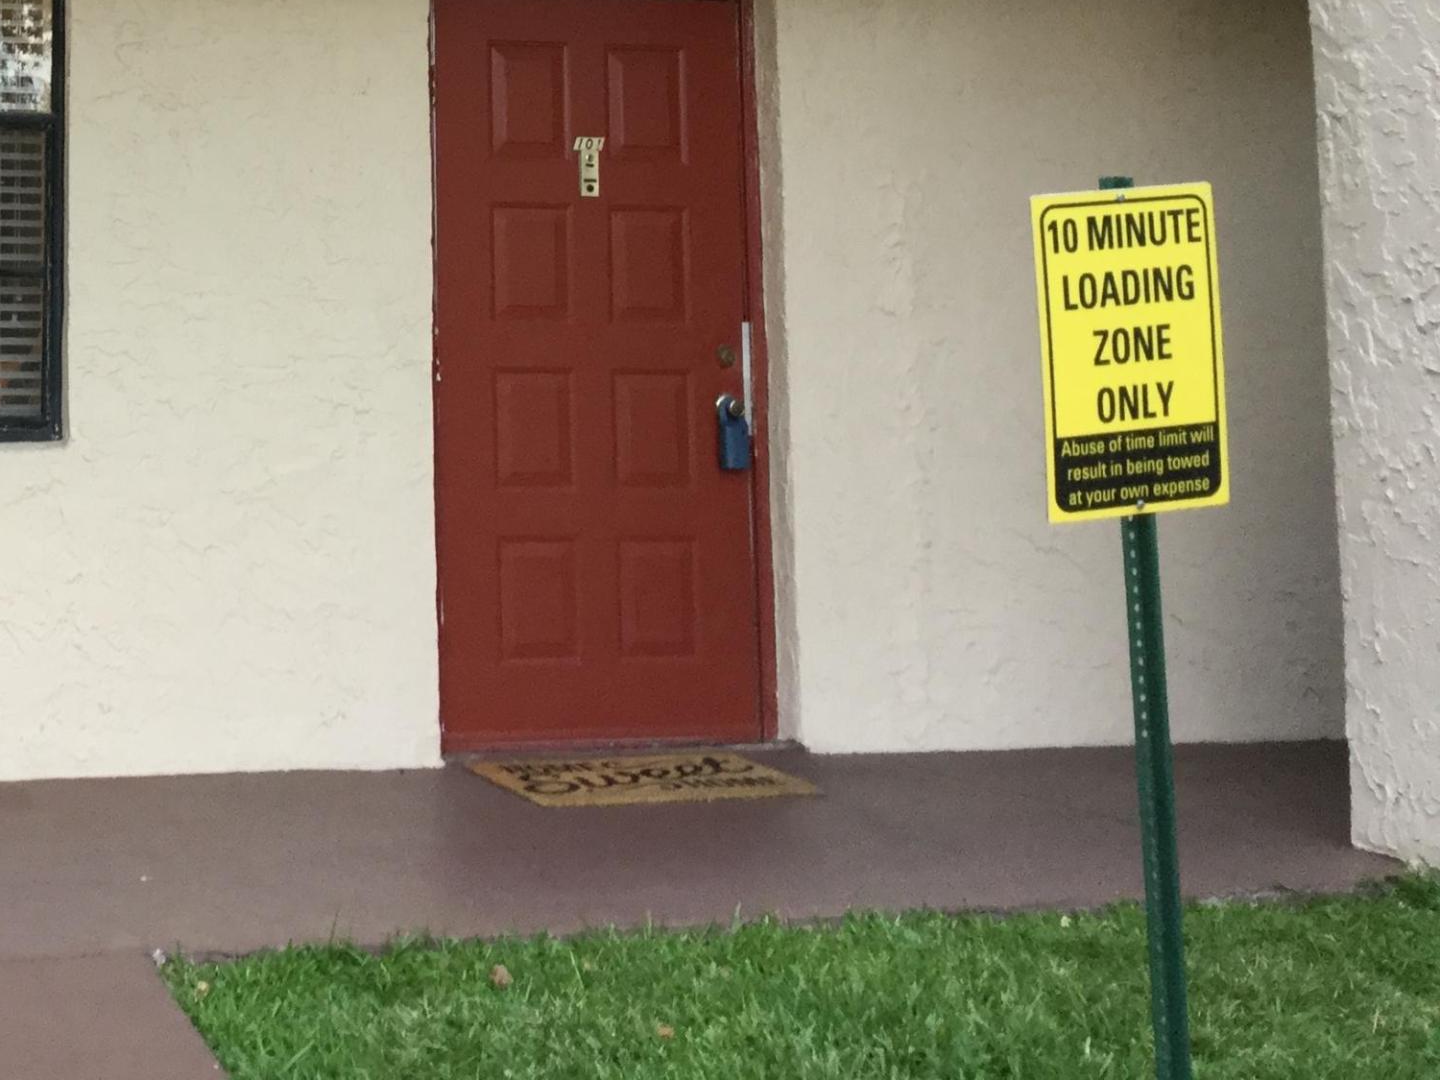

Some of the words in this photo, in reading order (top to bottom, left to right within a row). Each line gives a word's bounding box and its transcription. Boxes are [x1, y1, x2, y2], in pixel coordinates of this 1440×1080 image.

[1048, 218, 1079, 254] 10
[1087, 208, 1202, 252] MINUTE
[1062, 264, 1195, 311] LOADING
[1093, 323, 1173, 366] ZONE
[1096, 381, 1175, 424] ONLY
[1061, 438, 1105, 458] Abuse
[1109, 436, 1123, 453] of
[1126, 433, 1155, 451] time
[1159, 429, 1187, 447] limit
[1190, 425, 1214, 443] will
[1067, 460, 1107, 481] result
[1111, 459, 1122, 477] in
[1126, 455, 1164, 479] being
[1167, 450, 1210, 471] towed
[1068, 488, 1082, 506] at
[1086, 485, 1118, 508] your
[1120, 481, 1149, 499] own
[1153, 478, 1210, 500] expense
